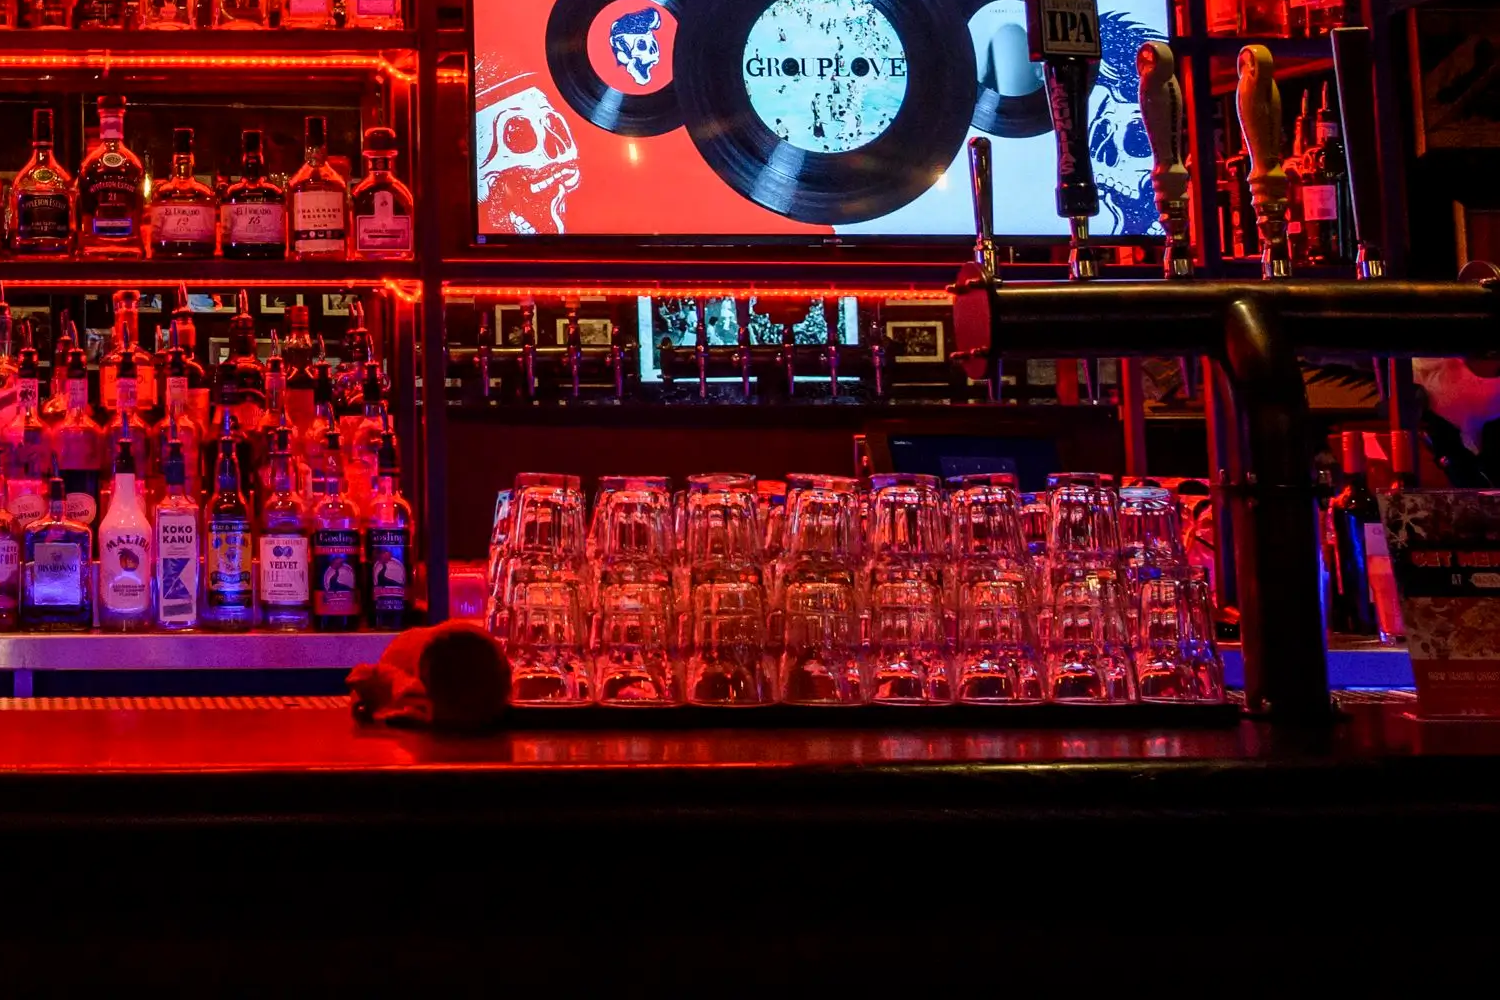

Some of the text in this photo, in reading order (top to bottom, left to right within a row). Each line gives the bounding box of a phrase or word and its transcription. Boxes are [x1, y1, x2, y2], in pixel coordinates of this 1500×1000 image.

[1046, 11, 1094, 43] IPA
[746, 57, 907, 78] GROUPLOVE
[162, 525, 193, 534] KOKO
[106, 534, 151, 553] MALIBU
[162, 535, 193, 544] KANU
[269, 561, 298, 570] VELVET
